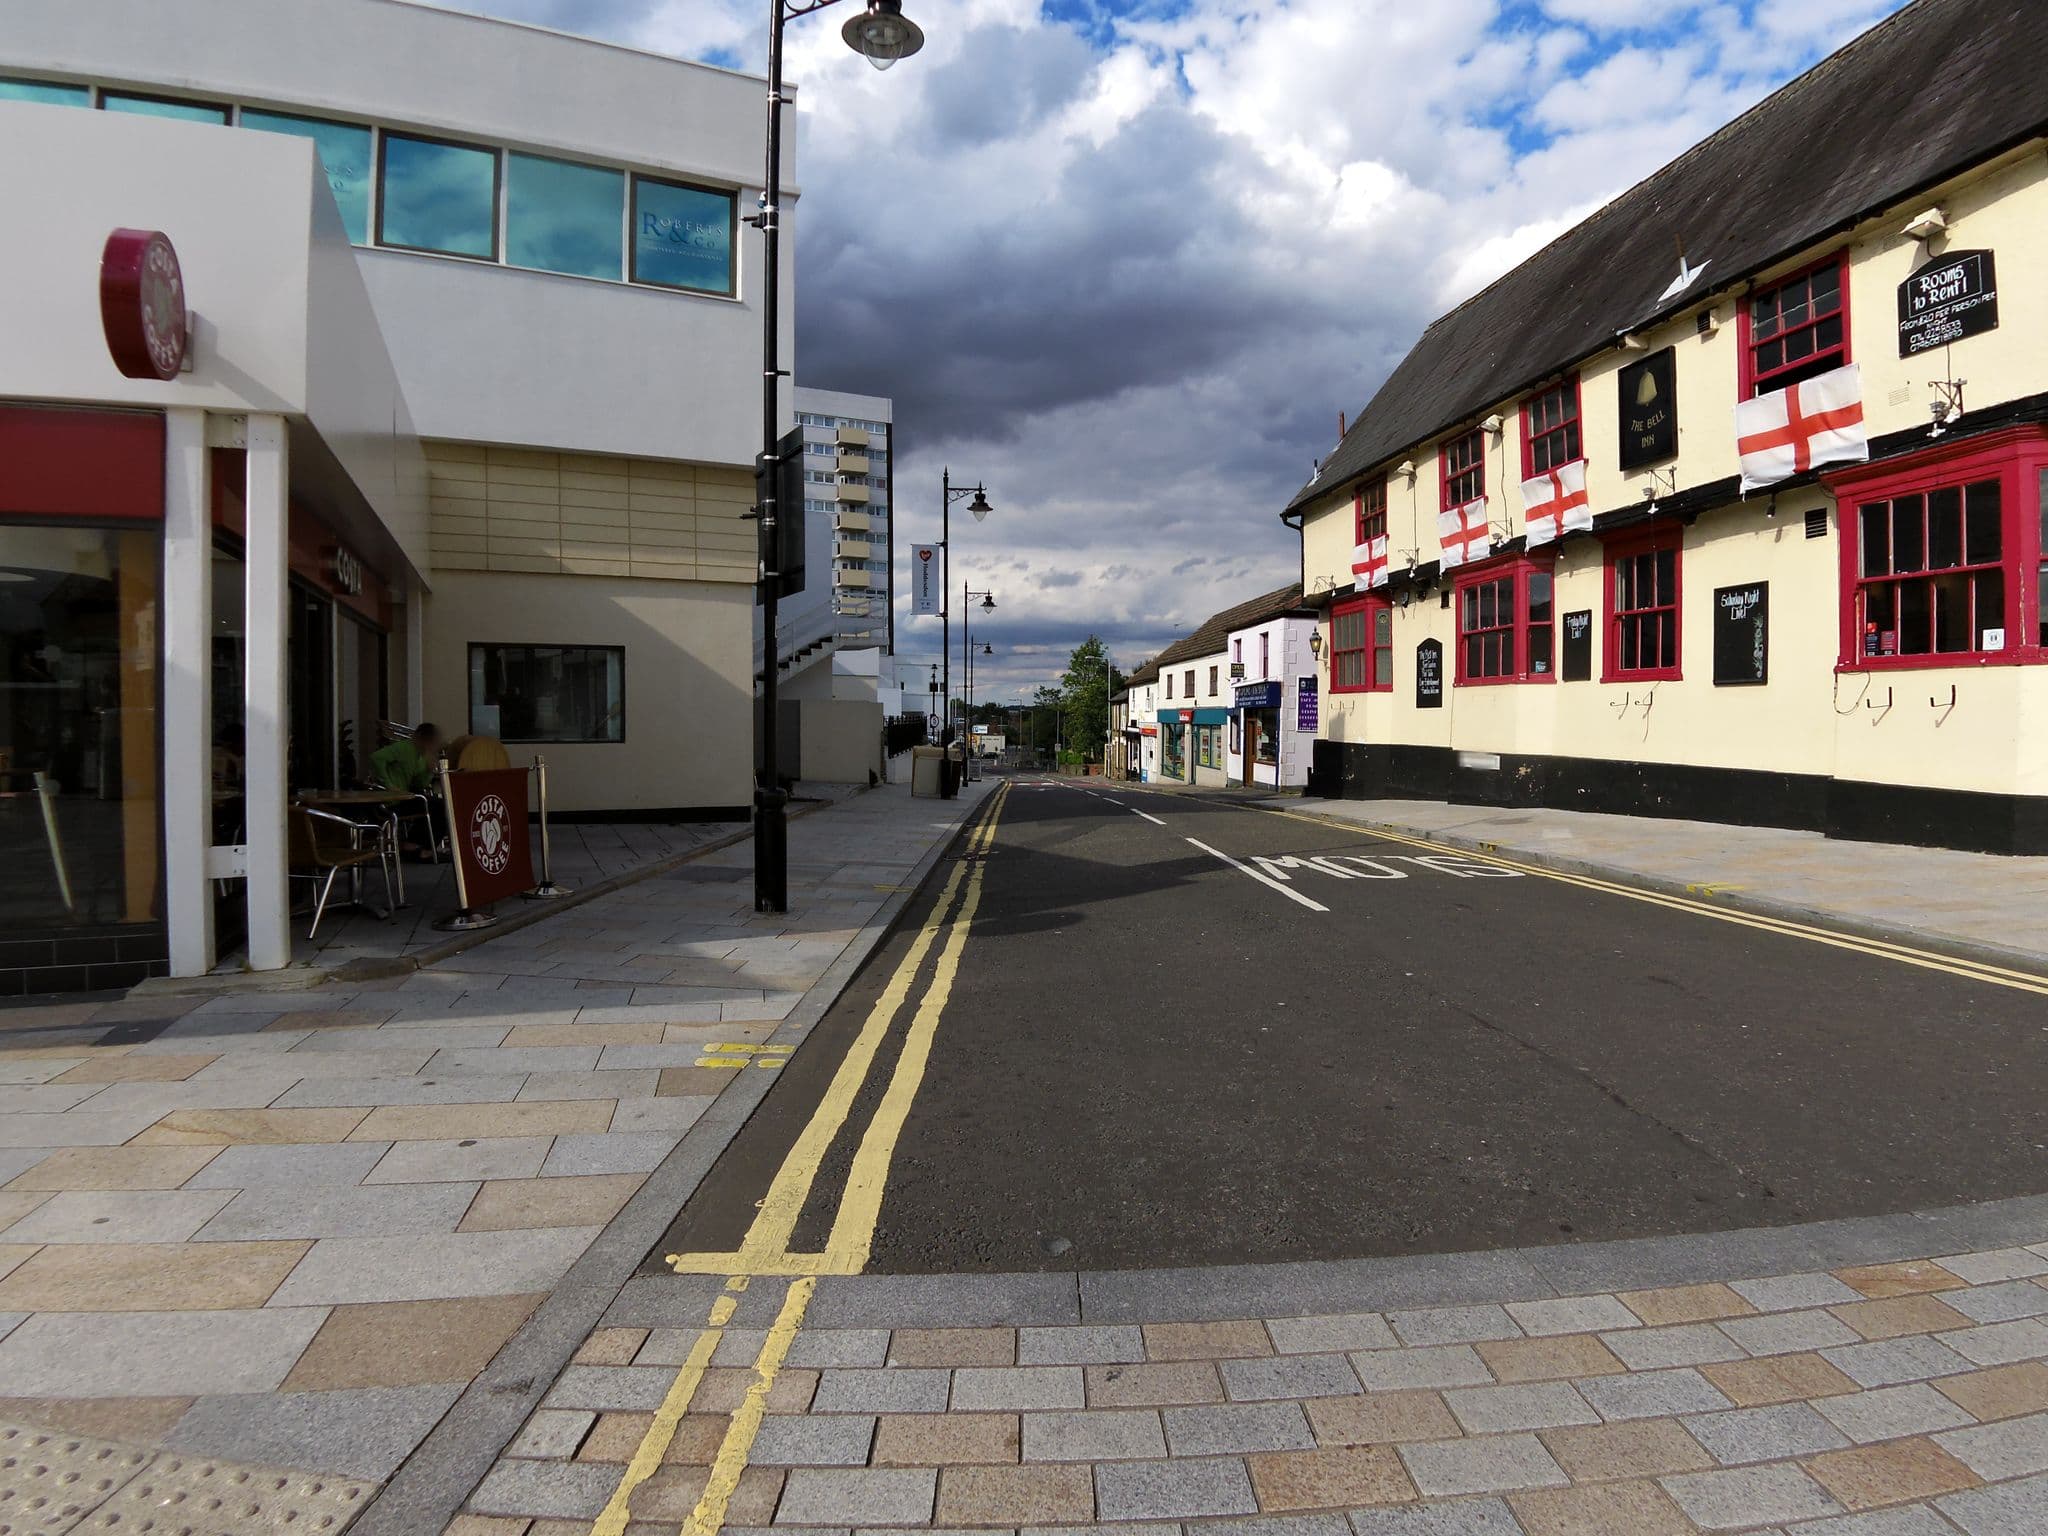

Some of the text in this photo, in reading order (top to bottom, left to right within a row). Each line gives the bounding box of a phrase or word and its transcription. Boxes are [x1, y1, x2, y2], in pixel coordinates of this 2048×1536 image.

[1630, 410, 1666, 432] THE BELL
[1641, 434, 1655, 448] INN
[337, 547, 361, 595] COSTA
[475, 798, 503, 823] COSTA
[476, 841, 509, 872] COFFEE
